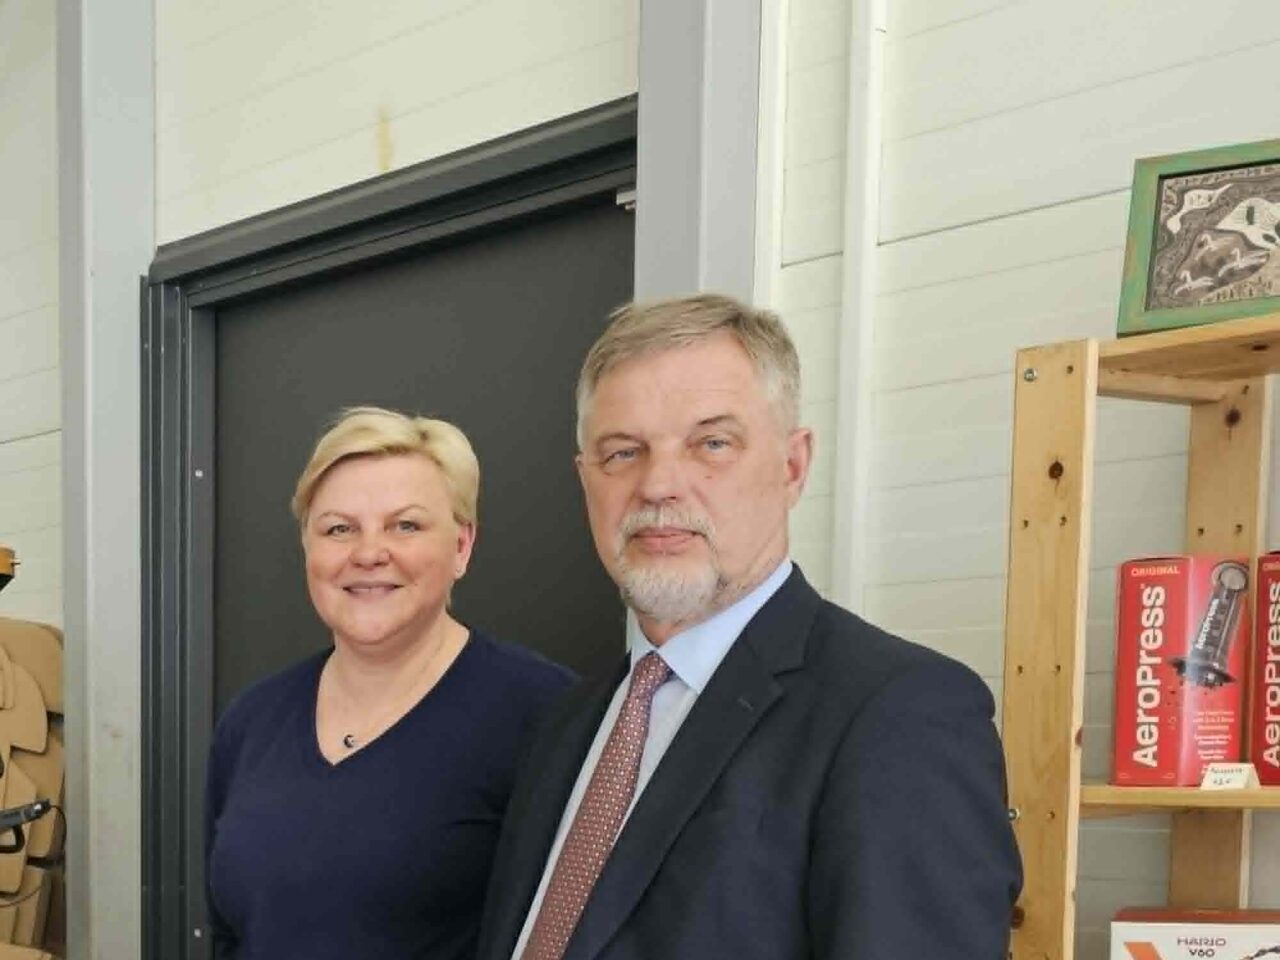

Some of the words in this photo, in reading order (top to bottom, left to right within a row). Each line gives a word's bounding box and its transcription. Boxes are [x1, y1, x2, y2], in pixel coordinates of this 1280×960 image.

[1132, 586, 1167, 769] AeroPress
[1177, 937, 1227, 947] HARIO
[1188, 949, 1216, 958] V60
